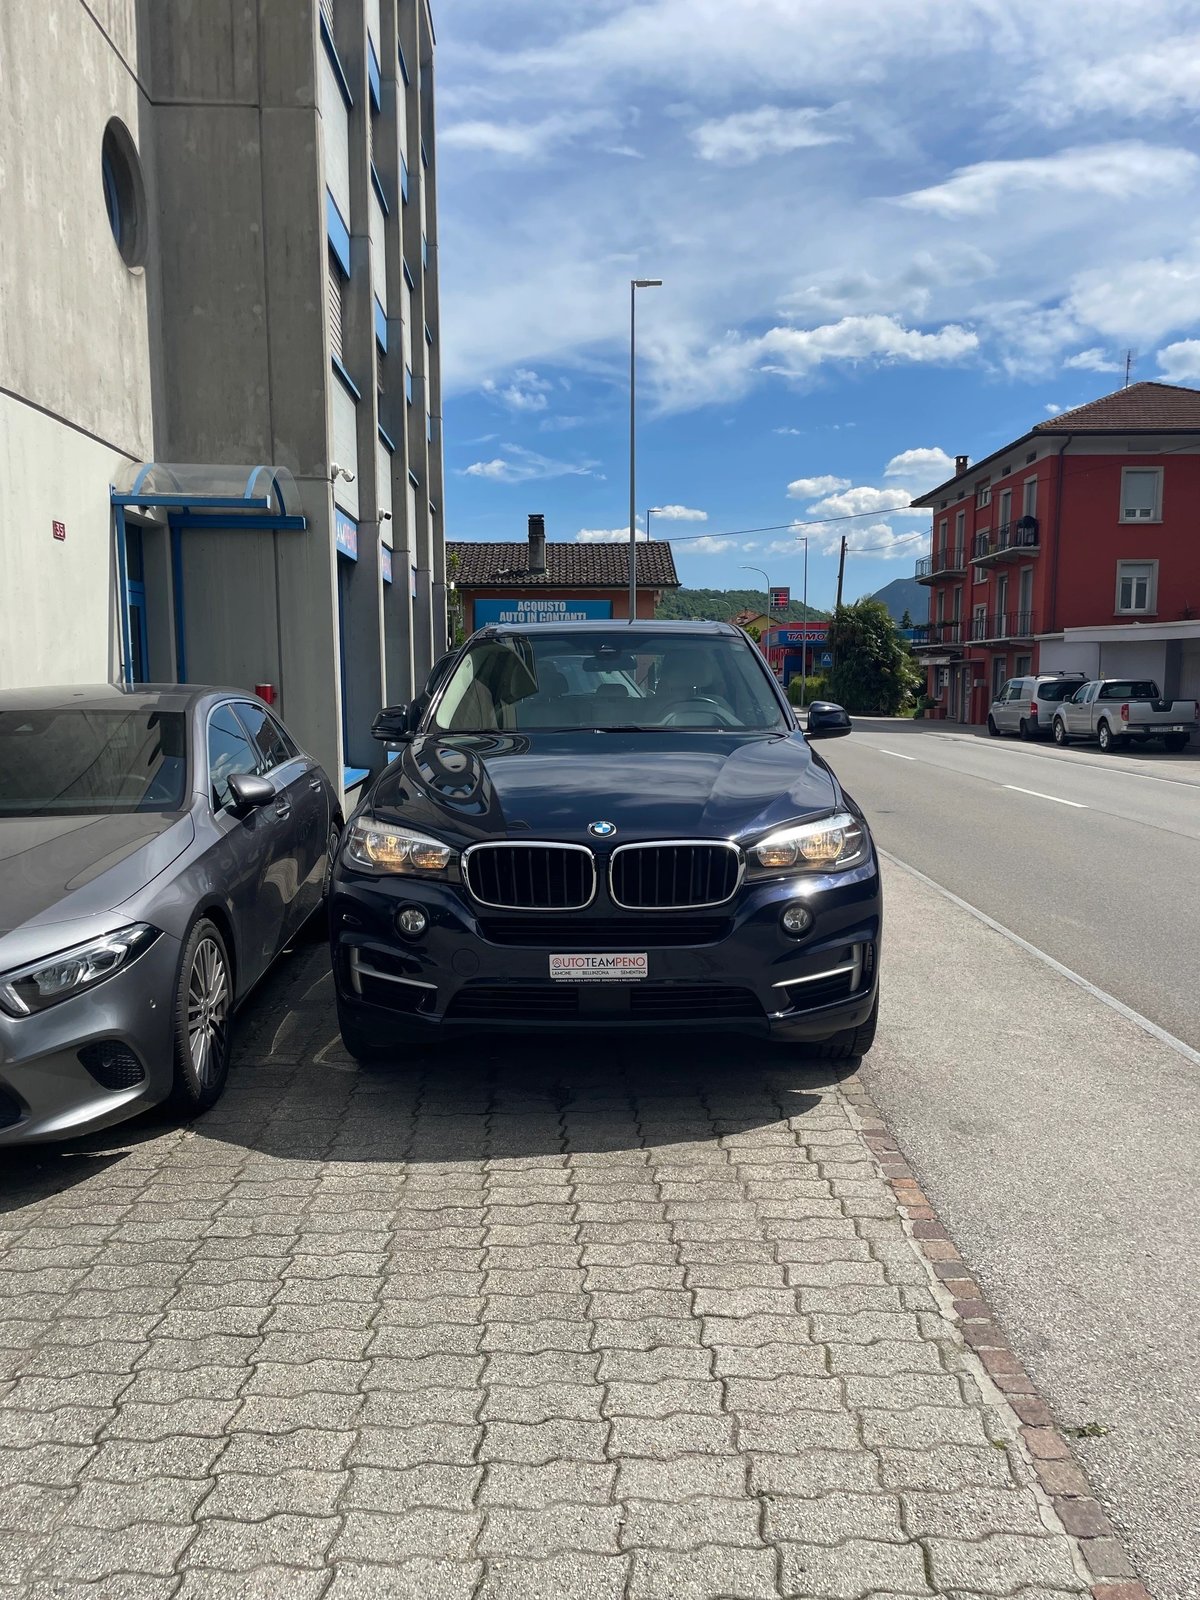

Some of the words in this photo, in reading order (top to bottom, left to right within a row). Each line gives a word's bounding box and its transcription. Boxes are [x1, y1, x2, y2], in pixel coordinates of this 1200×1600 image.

[55, 523, 64, 536] 35
[517, 602, 566, 612] ACQUISTO
[499, 612, 525, 622] AUTO
[526, 612, 537, 623] IN
[539, 612, 586, 622] CONTANTI
[787, 632, 827, 641] TAMO
